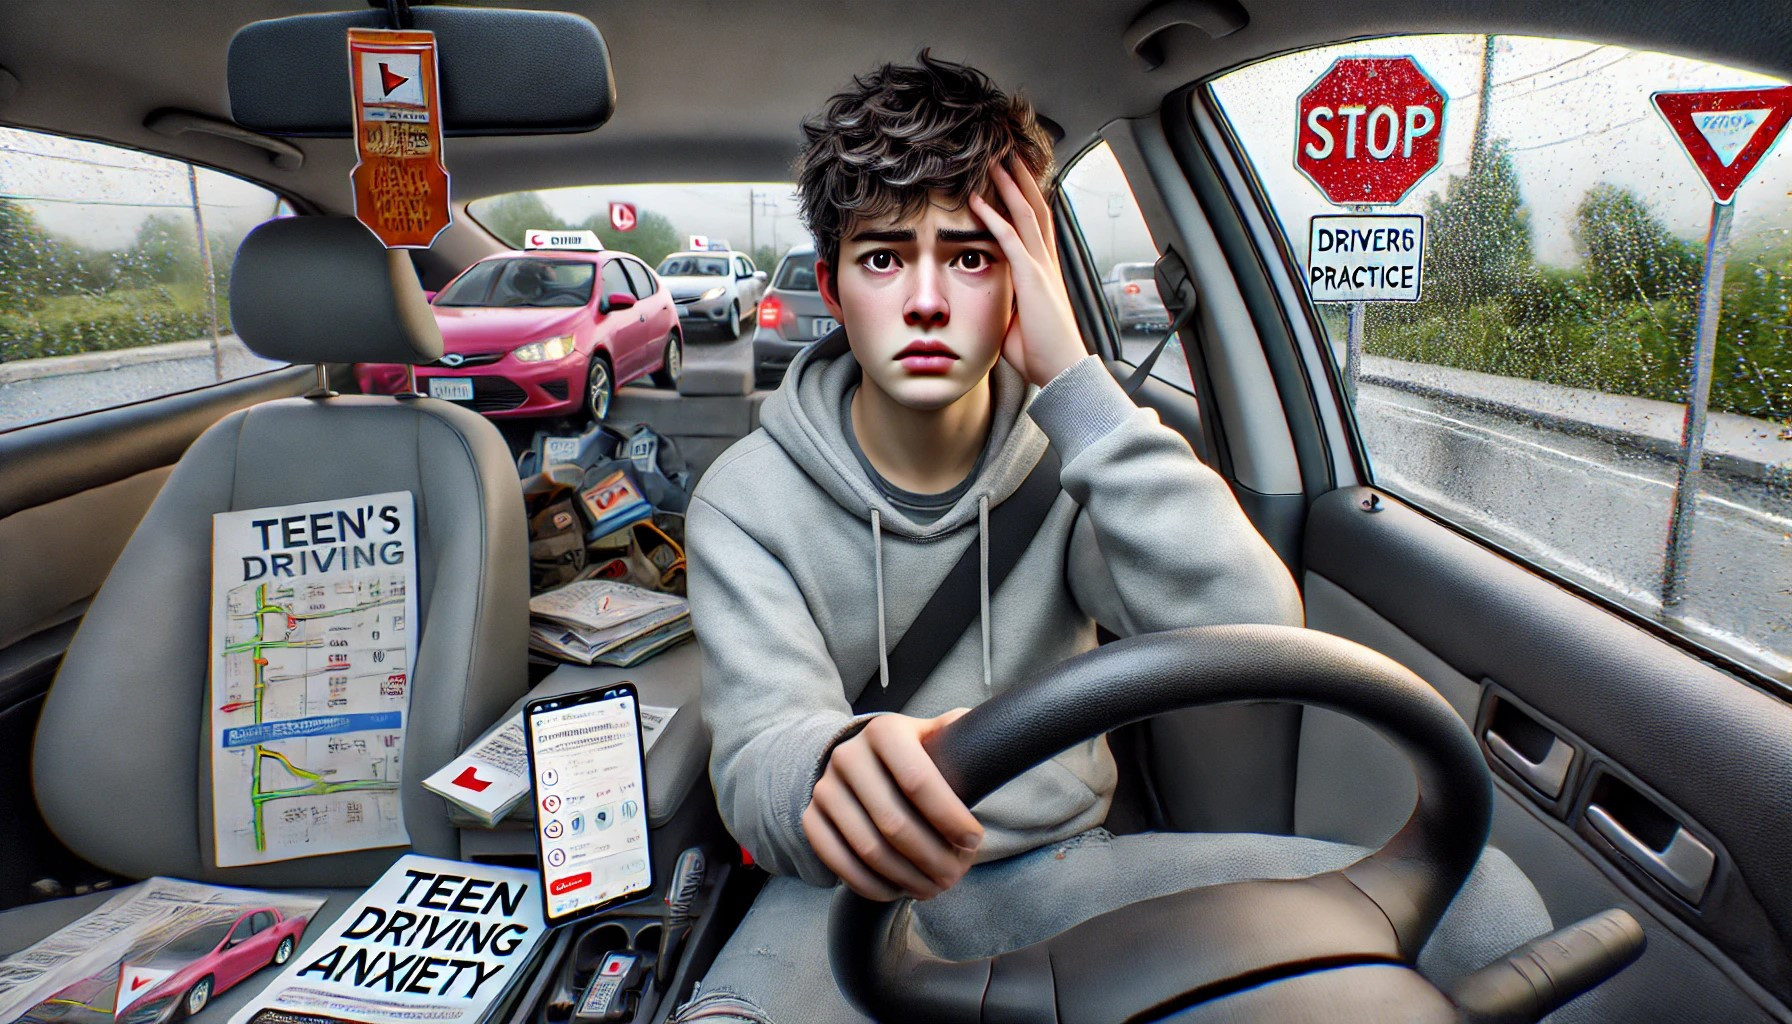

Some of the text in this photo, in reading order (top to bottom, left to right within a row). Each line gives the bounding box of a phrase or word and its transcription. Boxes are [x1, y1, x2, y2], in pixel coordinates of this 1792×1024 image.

[1305, 104, 1436, 160] STOP
[1310, 265, 1414, 291] PRACTICE
[252, 505, 401, 551] TEEN'S
[242, 540, 405, 582] DRIVING
[397, 869, 529, 917] TEEN
[340, 906, 529, 957] DRIVING
[296, 945, 505, 1000] ANXIETY
